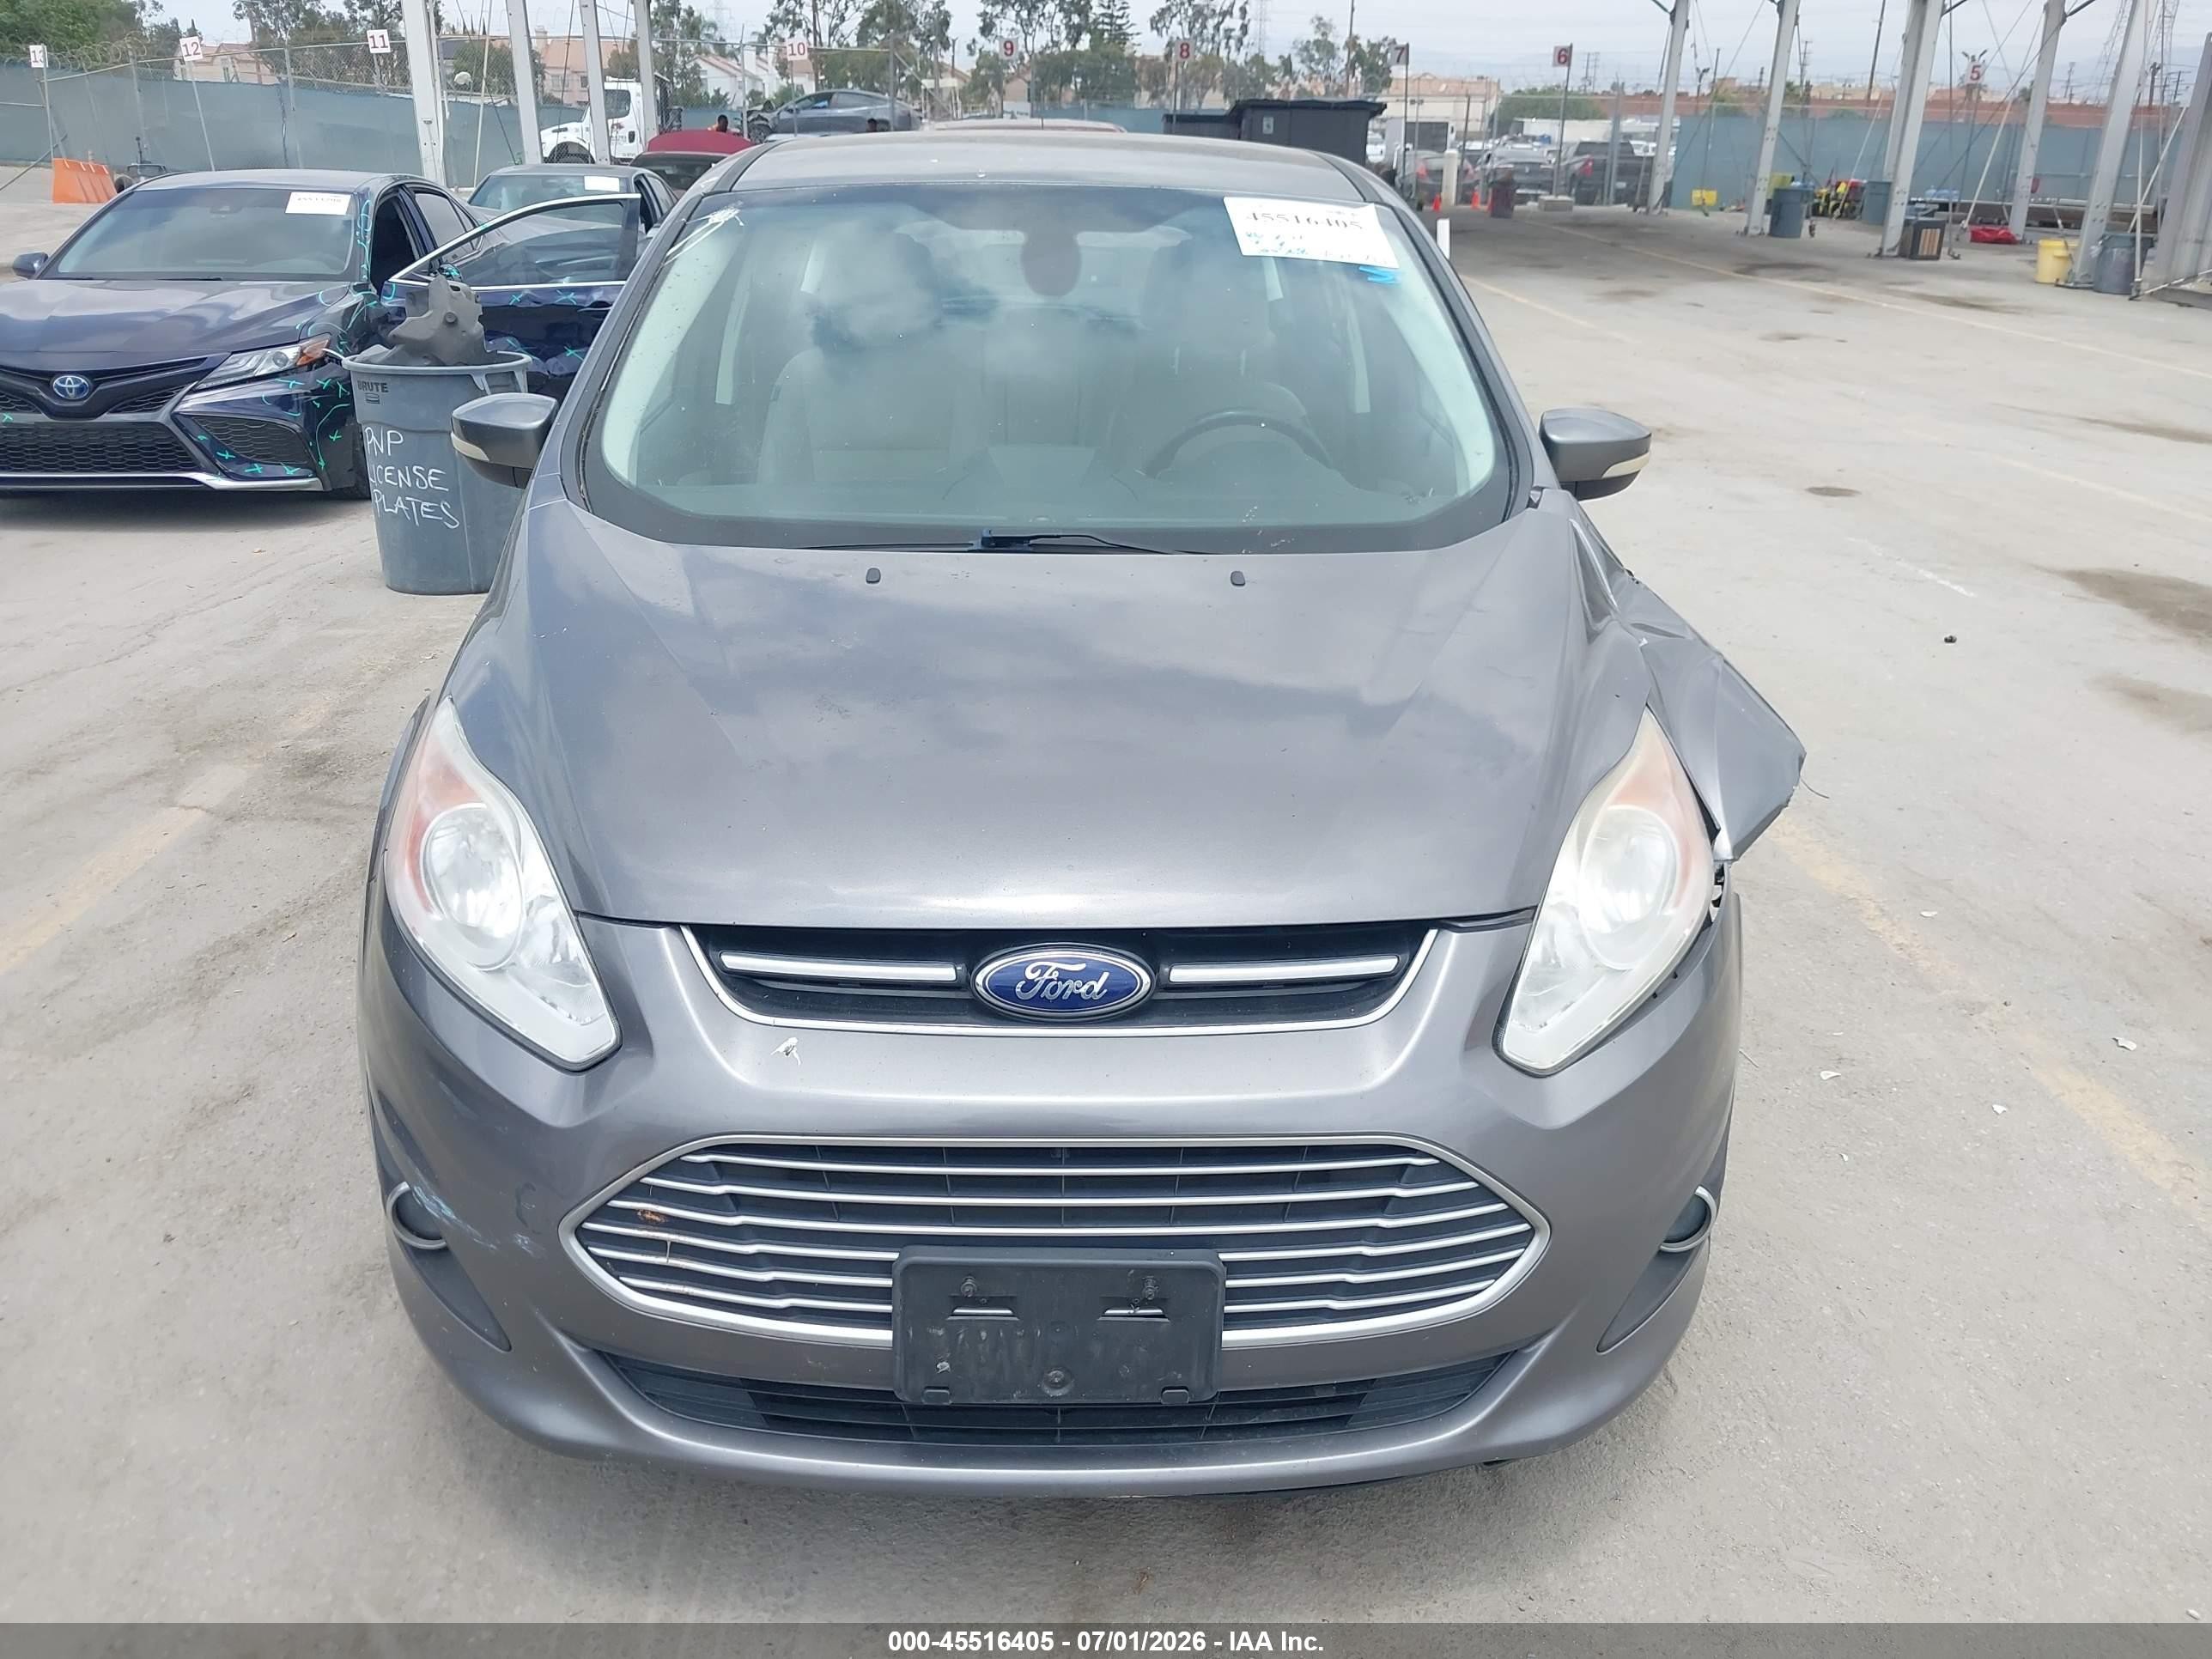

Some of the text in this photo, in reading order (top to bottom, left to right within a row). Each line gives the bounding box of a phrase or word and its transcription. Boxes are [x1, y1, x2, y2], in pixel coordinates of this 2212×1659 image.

[182, 41, 201, 58] 12
[369, 34, 389, 49] 11
[788, 42, 805, 56] 10
[1004, 40, 1014, 57] 9
[1180, 43, 1190, 59] 8
[1394, 46, 1405, 63] 7
[1558, 47, 1568, 64] 6
[1970, 64, 1981, 81] 5
[356, 380, 389, 393] BRUTE
[364, 426, 404, 458] PNP
[373, 489, 460, 529] PLATES
[1015, 960, 1110, 1001] Ford
